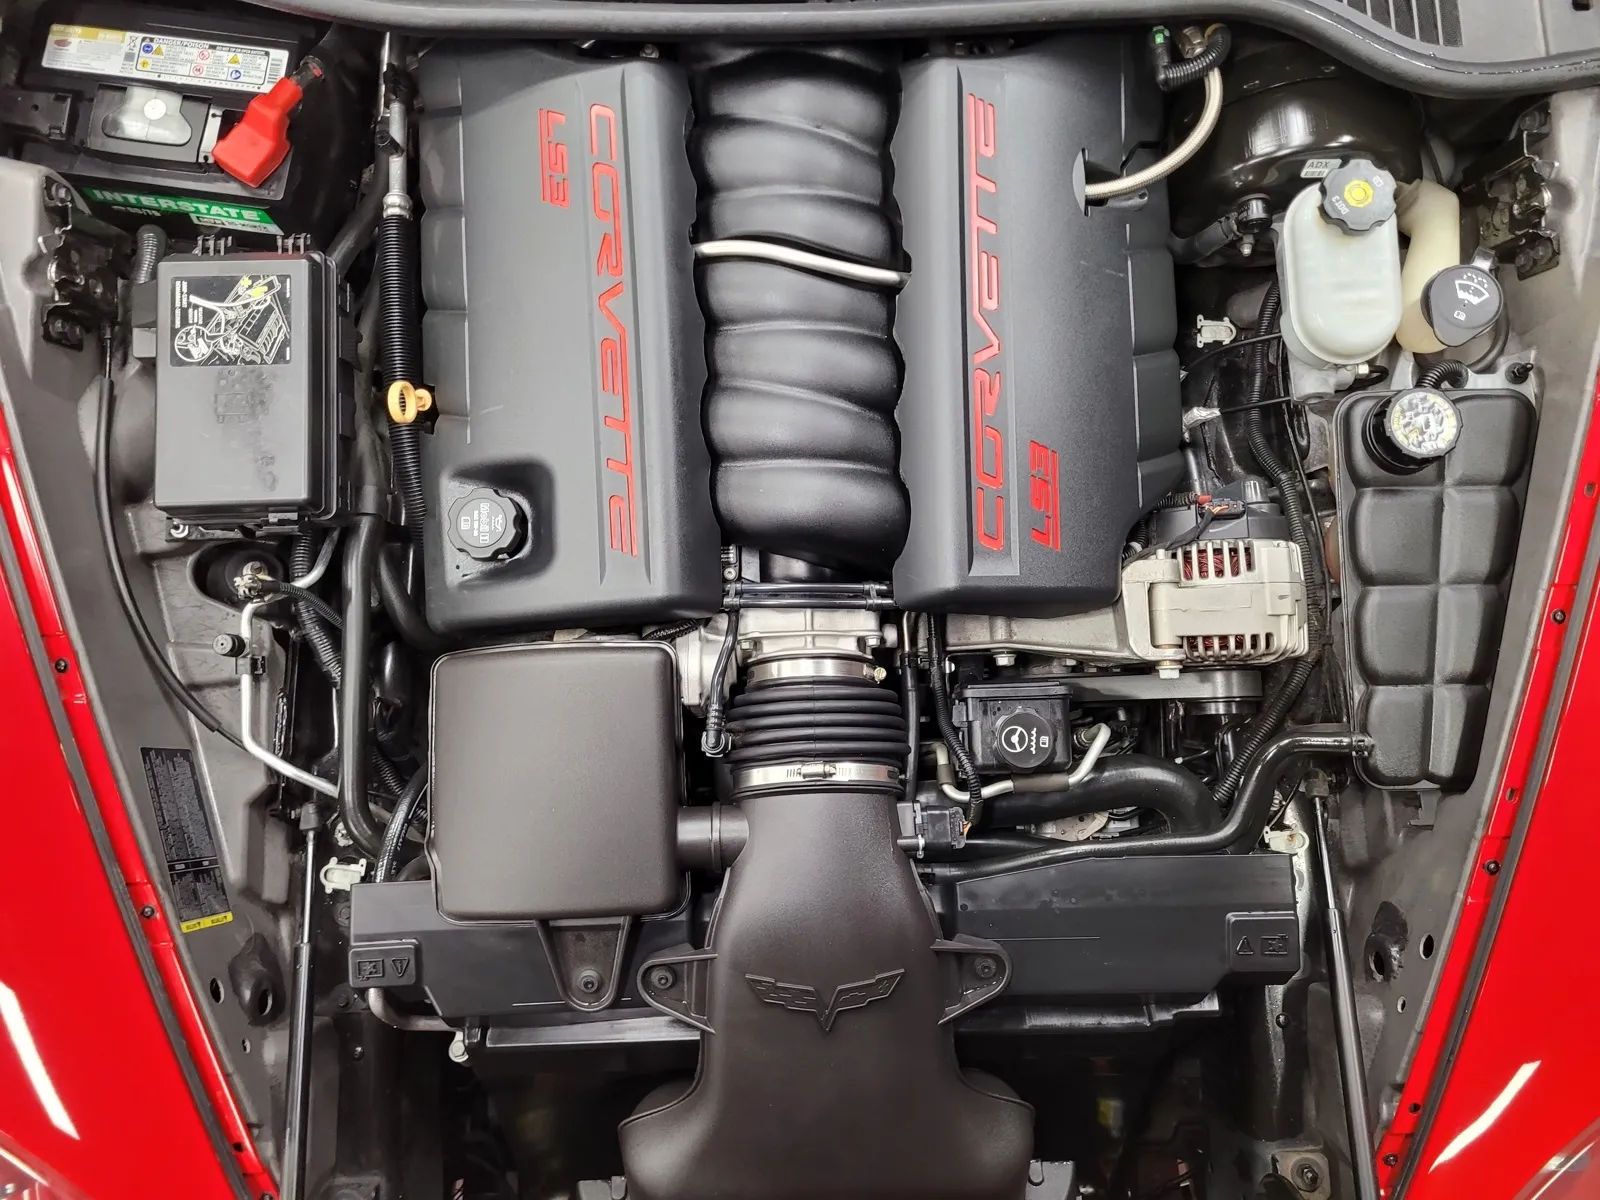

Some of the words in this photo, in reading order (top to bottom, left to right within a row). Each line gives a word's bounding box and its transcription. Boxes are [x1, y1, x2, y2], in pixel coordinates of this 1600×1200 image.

[153, 38, 209, 49] DANGER/POISON
[543, 108, 570, 209] LS3
[1308, 161, 1330, 169] ADX
[93, 189, 261, 221] INTERSTATE
[590, 103, 638, 557] CORVETTE
[968, 93, 1004, 551] CORVETTE
[480, 503, 490, 532] Mobil
[1029, 440, 1056, 549] LS3
